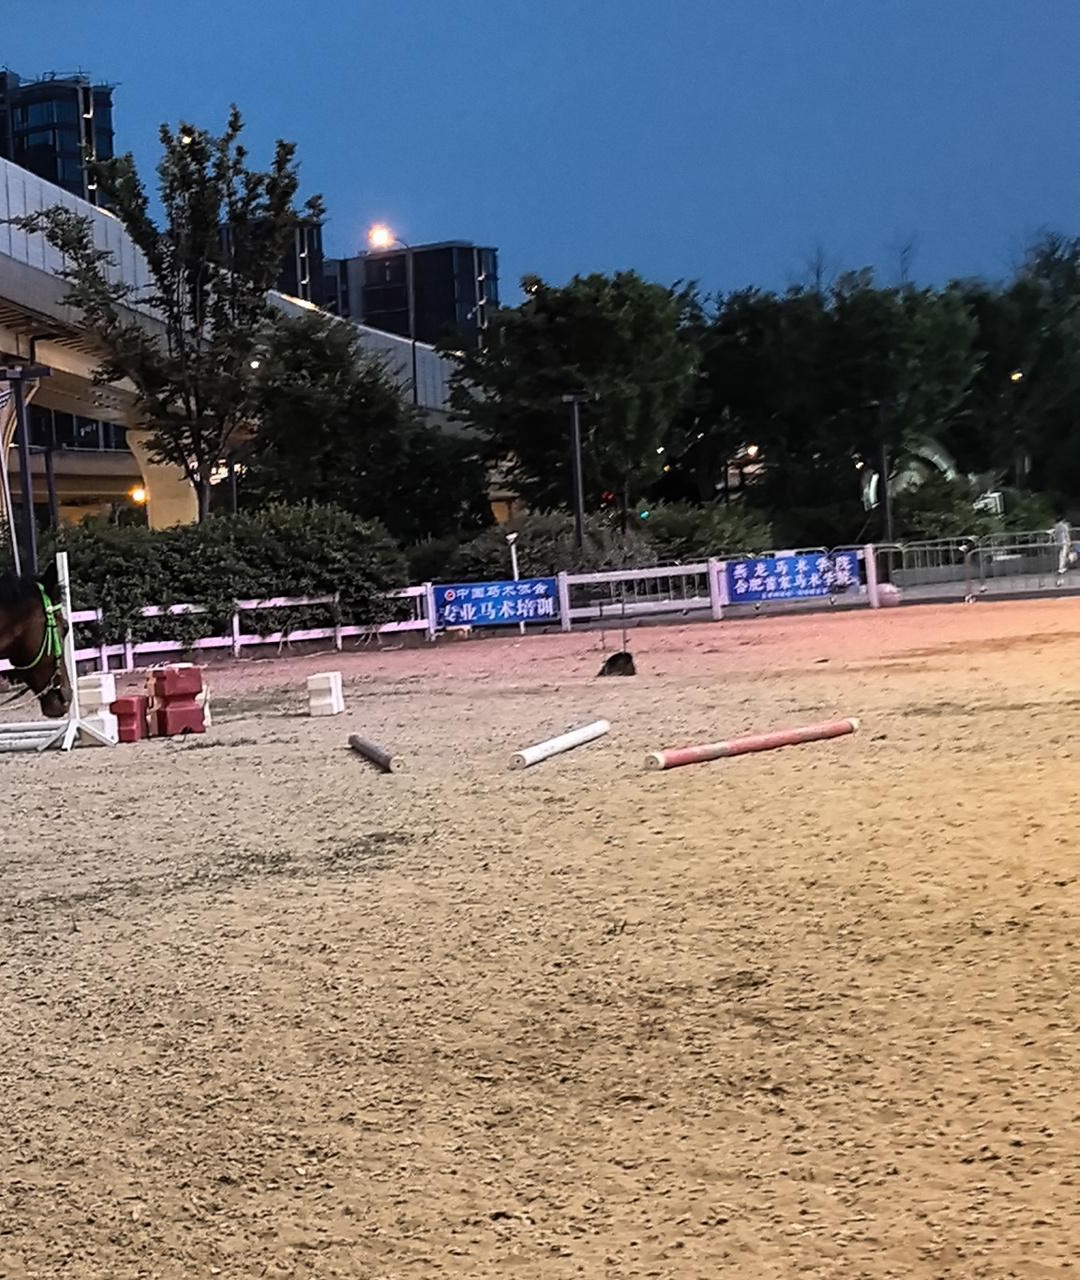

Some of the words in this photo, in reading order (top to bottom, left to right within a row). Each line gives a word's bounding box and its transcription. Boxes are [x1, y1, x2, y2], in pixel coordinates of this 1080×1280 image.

[443, 597, 553, 622] 专业马术培训
